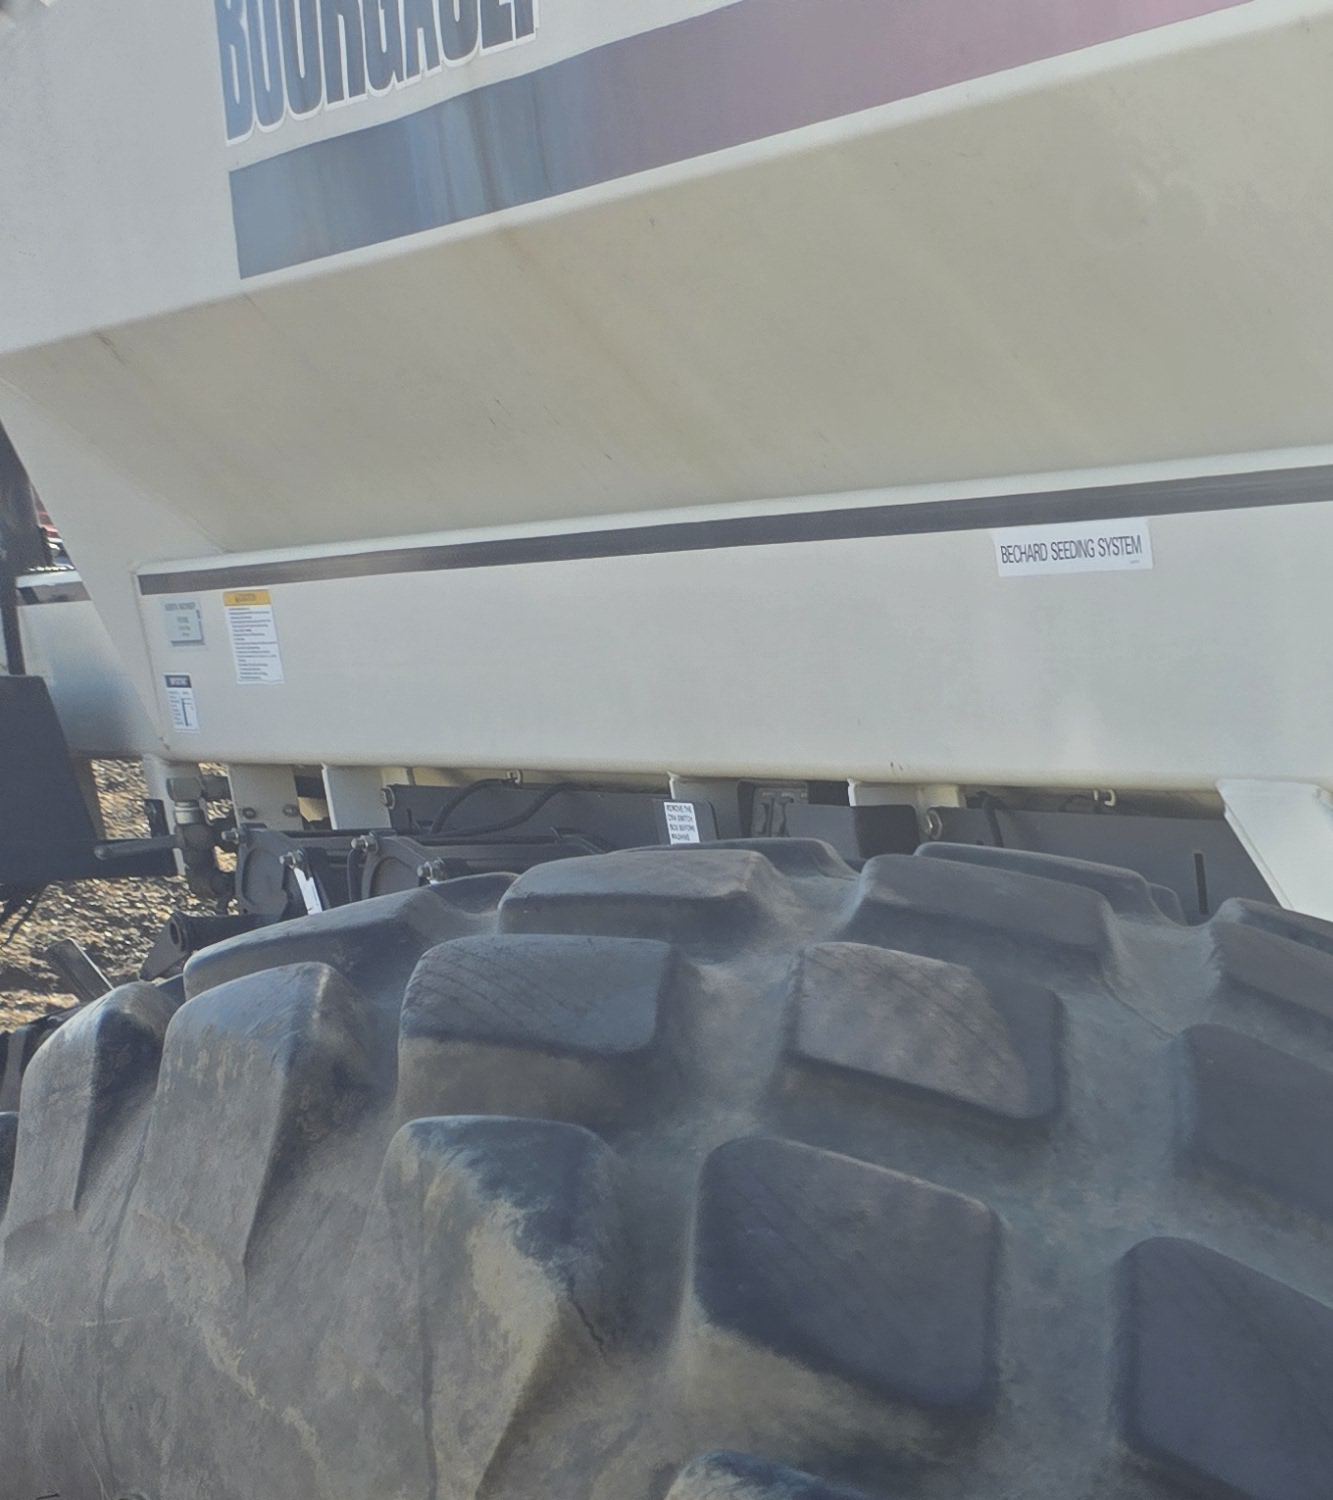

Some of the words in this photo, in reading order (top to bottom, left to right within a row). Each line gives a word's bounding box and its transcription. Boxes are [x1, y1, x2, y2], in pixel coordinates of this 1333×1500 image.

[1000, 543, 1048, 564] BECHARD
[1050, 539, 1095, 561] SEEDING
[1097, 535, 1143, 557] SYSTEM
